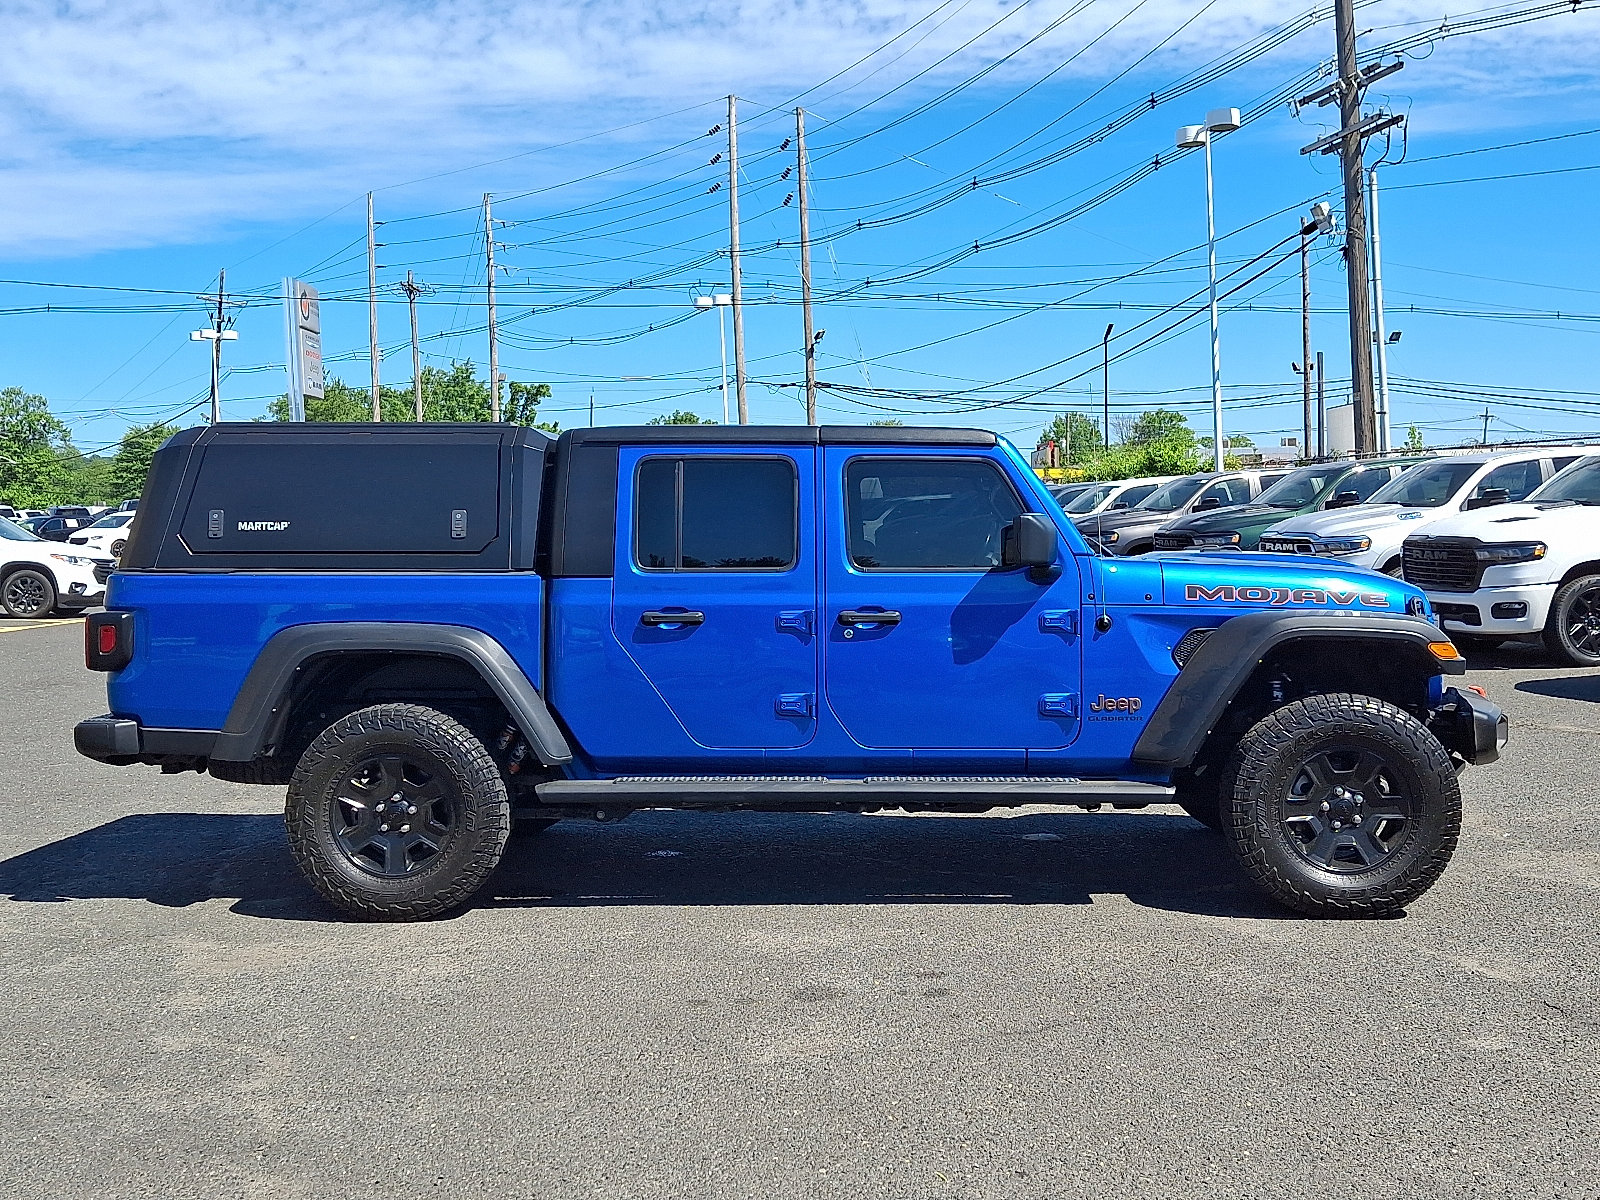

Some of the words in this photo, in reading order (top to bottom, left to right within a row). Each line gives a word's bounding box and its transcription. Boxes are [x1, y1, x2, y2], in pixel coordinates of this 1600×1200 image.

[237, 521, 288, 531] MARTCAP
[1265, 542, 1294, 551] RAM
[1412, 549, 1448, 560] RAM
[1184, 584, 1391, 608] MOJAVE
[1090, 694, 1142, 714] Jeep
